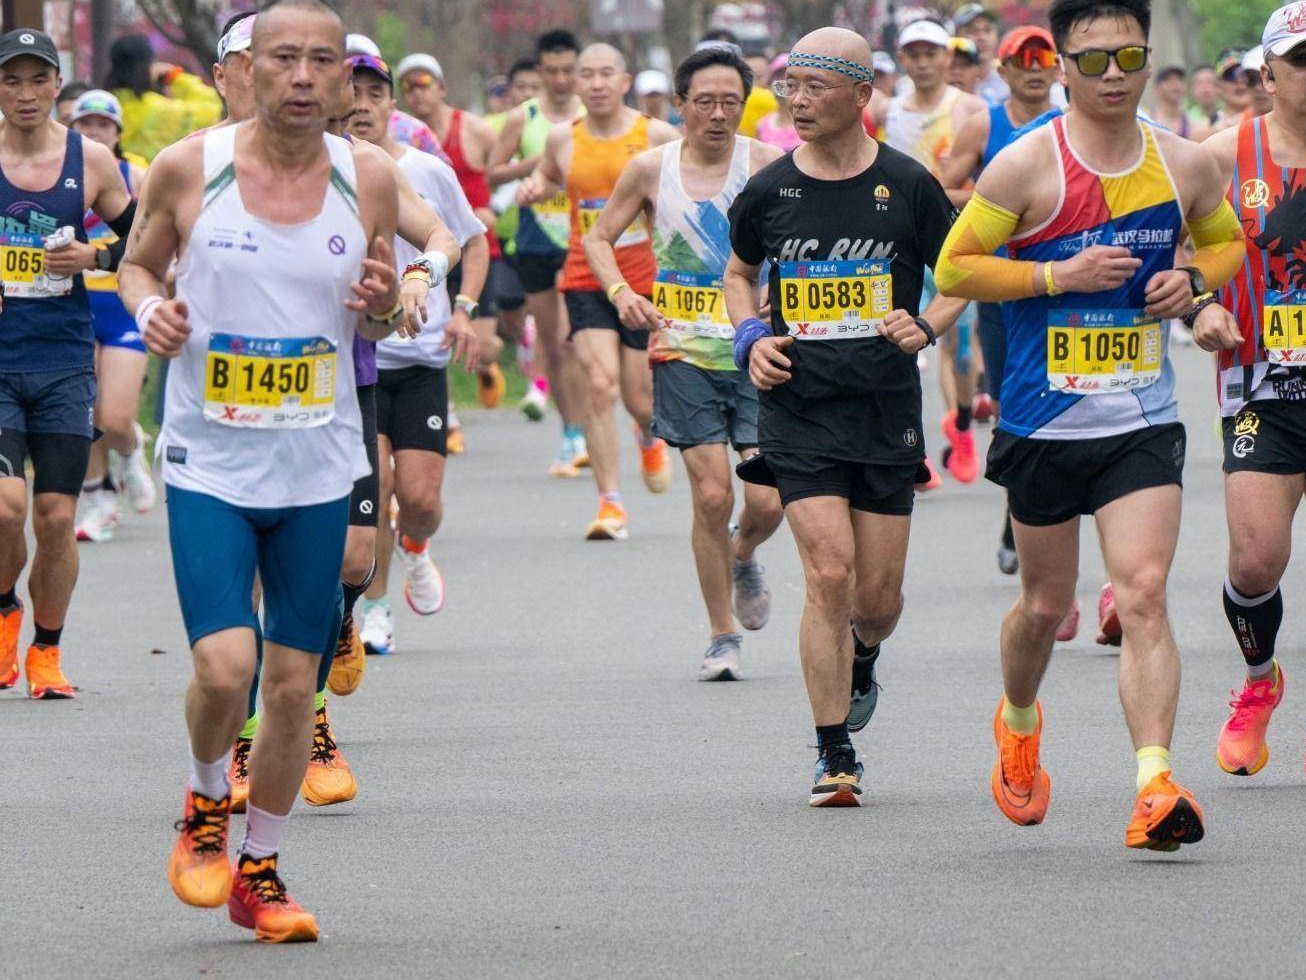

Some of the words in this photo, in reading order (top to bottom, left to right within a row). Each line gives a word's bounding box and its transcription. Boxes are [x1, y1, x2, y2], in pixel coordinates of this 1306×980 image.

[780, 188, 802, 197] HGC
[1111, 228, 1174, 245] 武汉马拉松
[6, 250, 42, 273] 065
[656, 286, 667, 308] A
[675, 289, 718, 313] 1067
[785, 283, 799, 309] B
[807, 281, 866, 309] 0583
[1269, 310, 1284, 336] A
[1054, 331, 1069, 360] B
[1080, 331, 1140, 361] 1050
[212, 358, 229, 388] B
[242, 361, 310, 394] 1450
